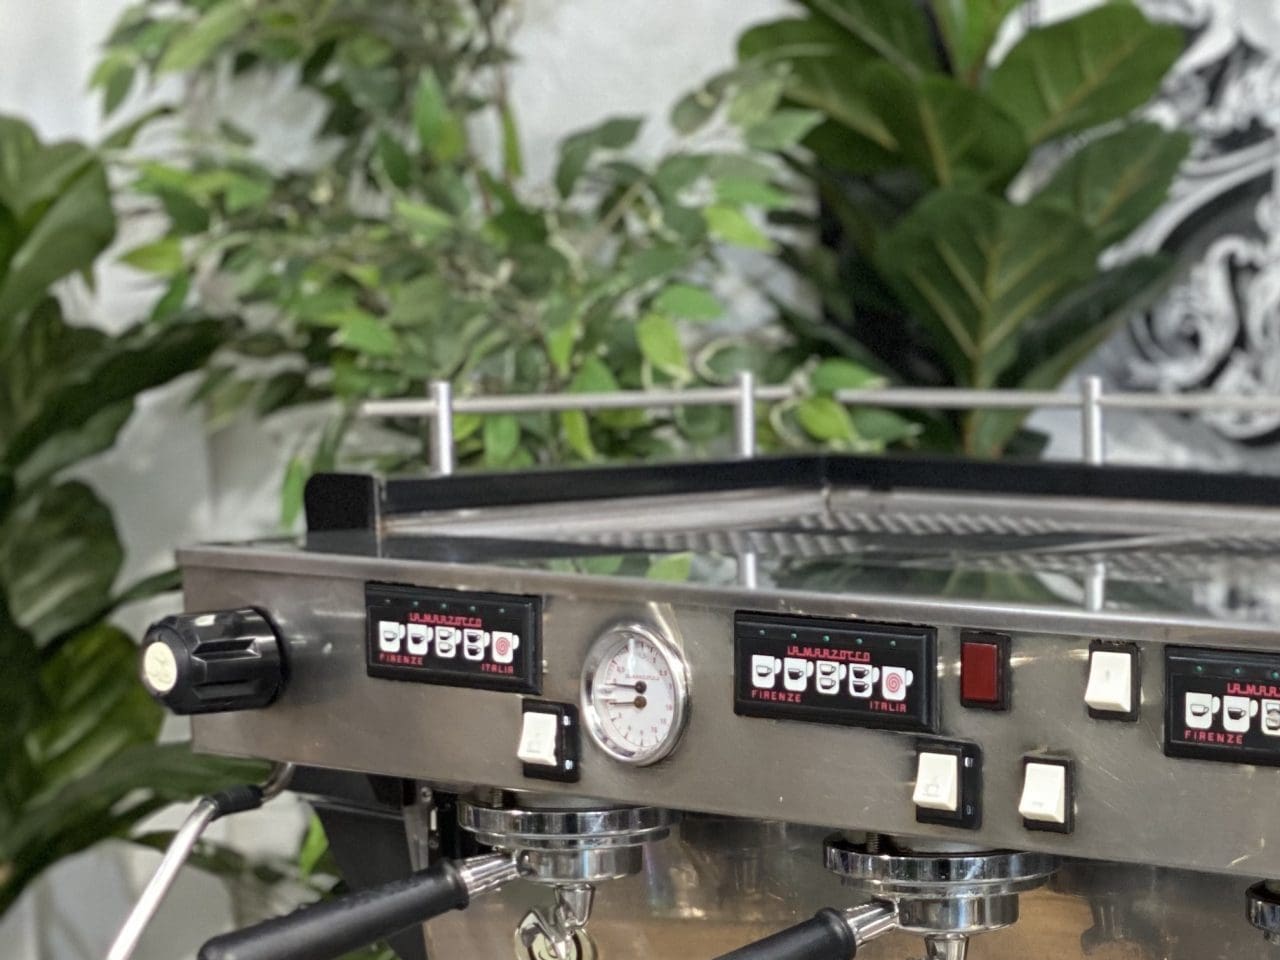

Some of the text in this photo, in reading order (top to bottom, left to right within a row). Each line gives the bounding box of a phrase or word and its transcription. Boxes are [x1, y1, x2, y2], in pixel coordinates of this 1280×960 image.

[378, 653, 424, 665] FIRENZE
[481, 663, 514, 674] ITALIA
[751, 689, 802, 703] FIRENZE
[869, 700, 907, 713] ITALIA
[1183, 729, 1244, 745] FIRENZE
